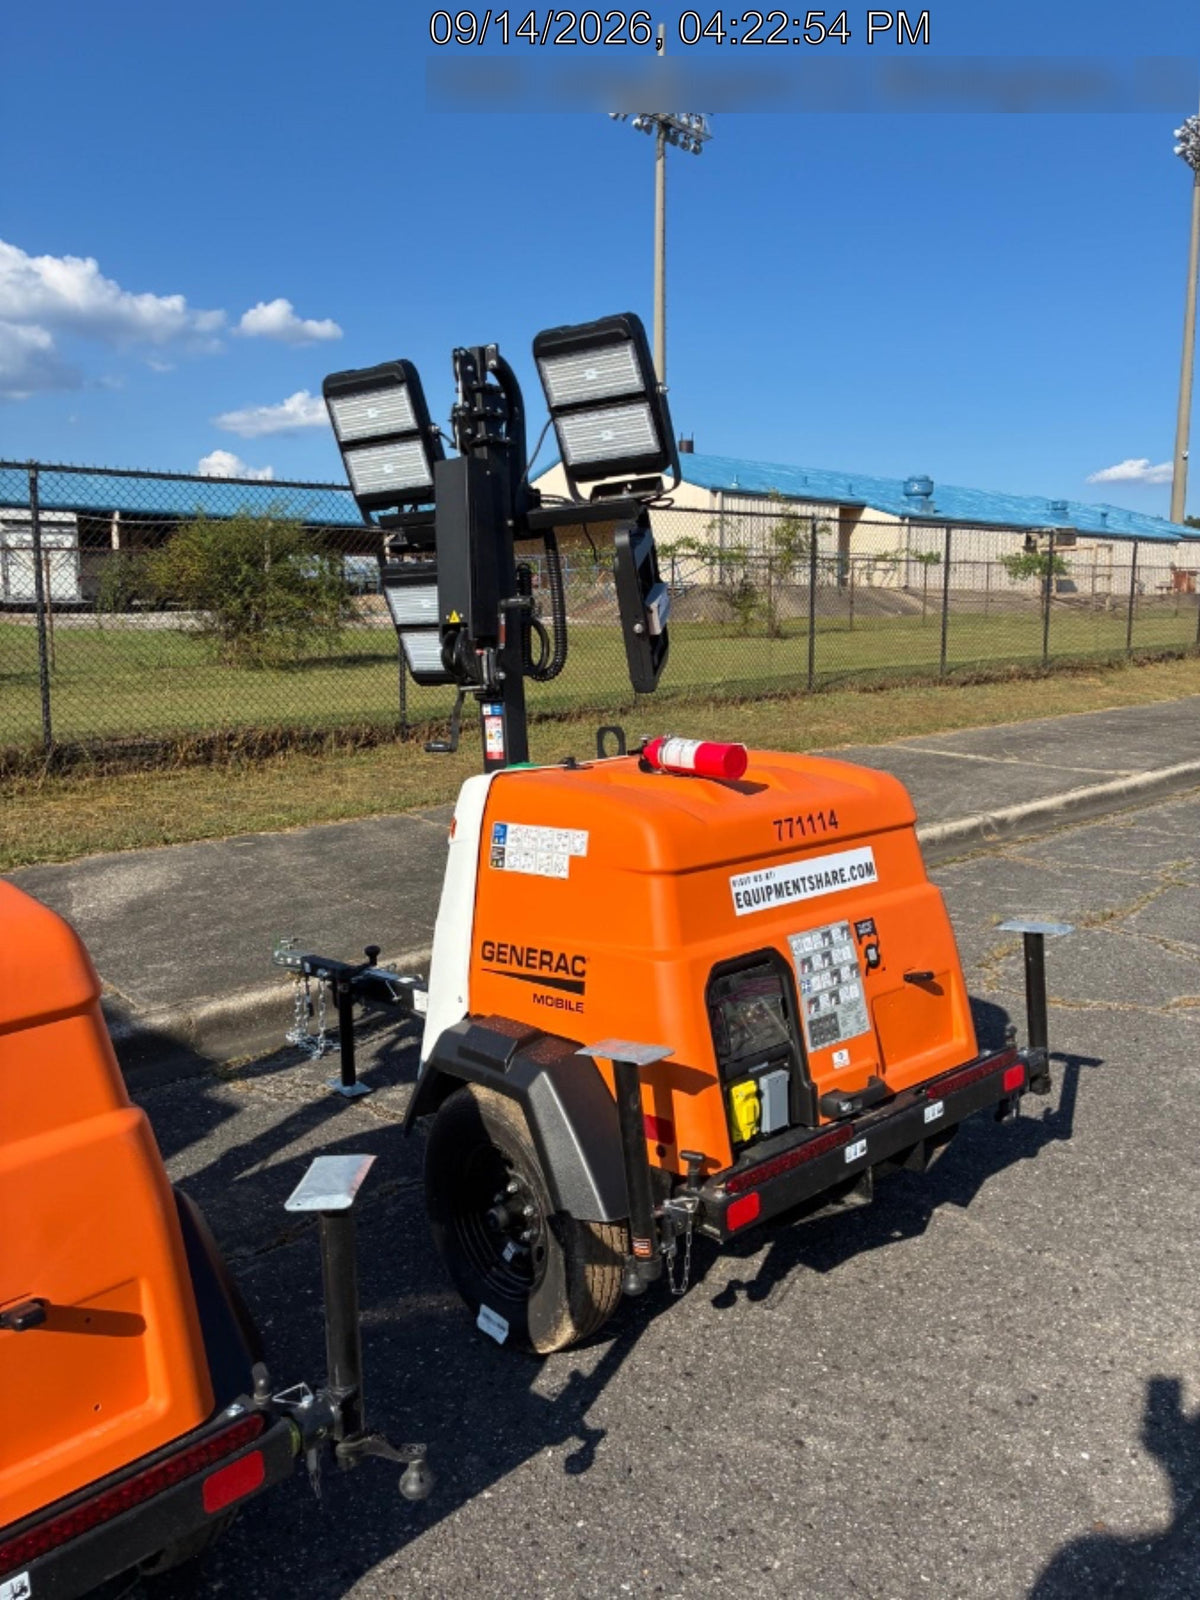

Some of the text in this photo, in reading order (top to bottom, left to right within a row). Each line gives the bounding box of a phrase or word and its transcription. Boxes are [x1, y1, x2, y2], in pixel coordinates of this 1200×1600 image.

[773, 809, 838, 841] 771114
[735, 861, 875, 909] EQUIPMENTSHARE.COM
[481, 940, 586, 978] GENERAC
[533, 993, 584, 1014] MOBILE
